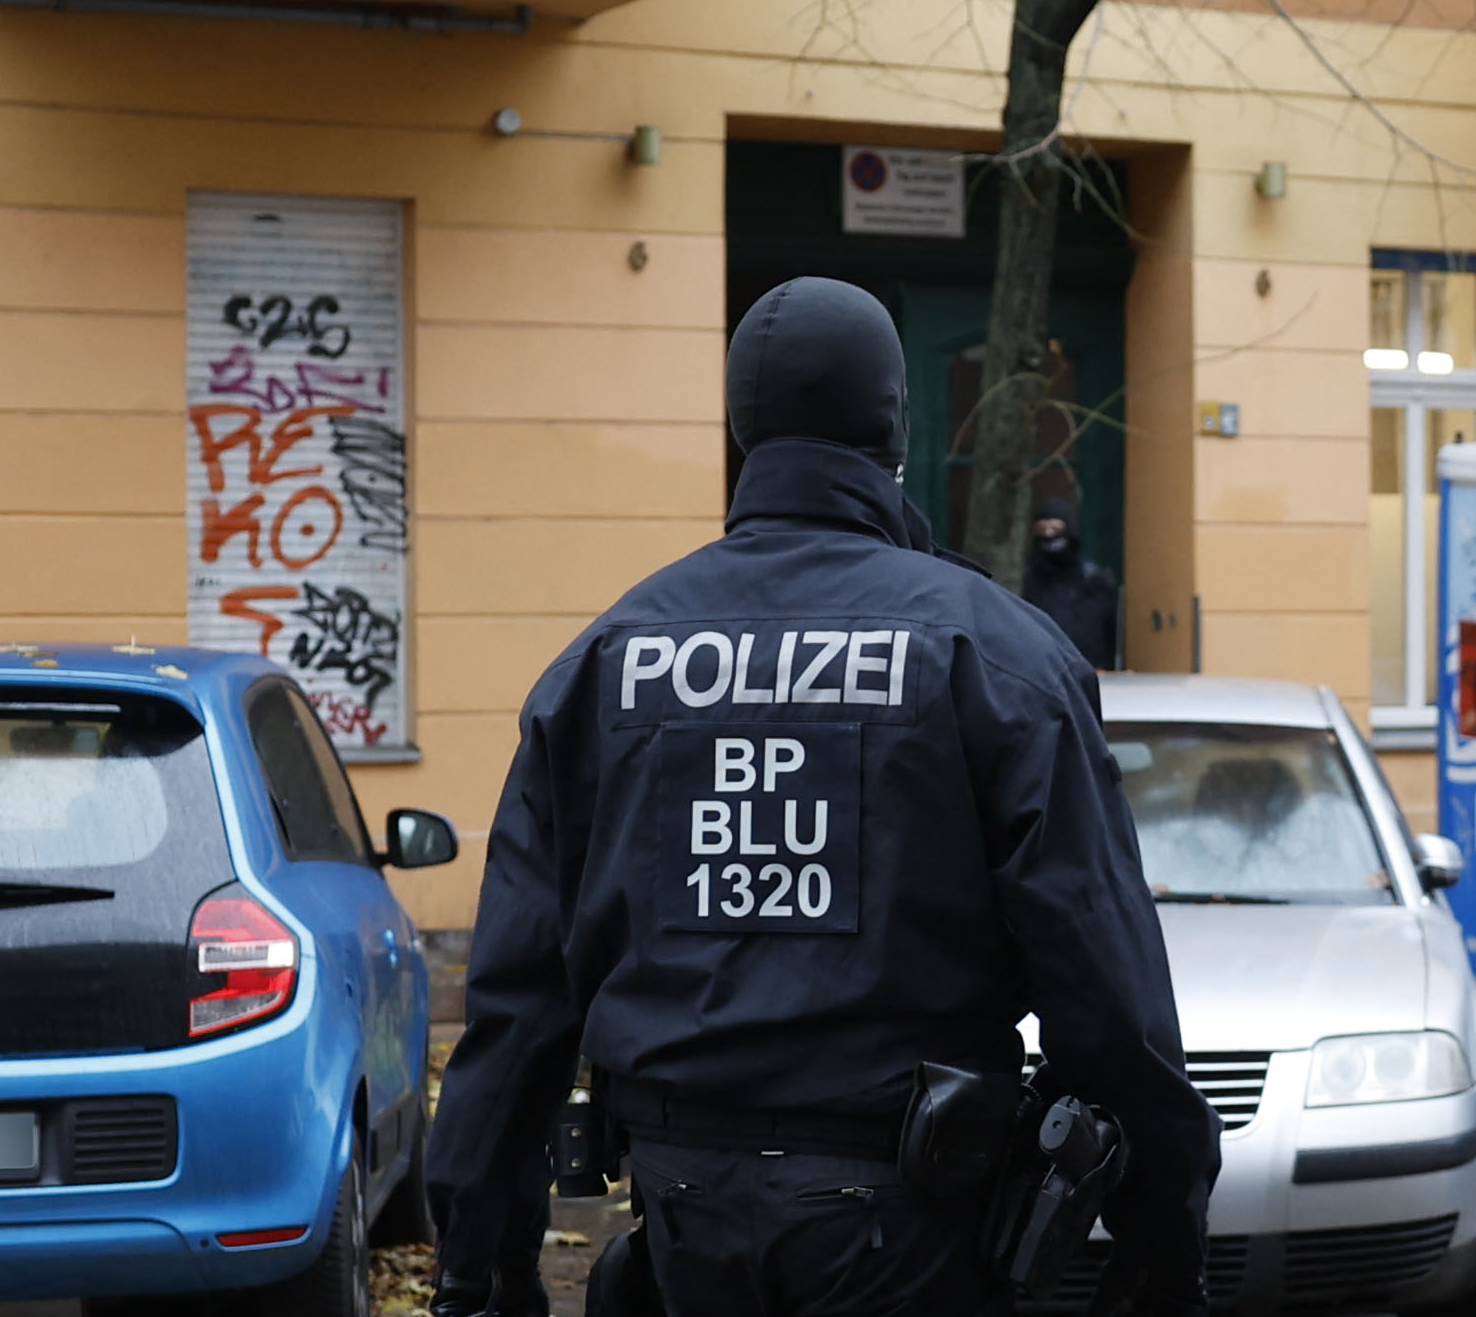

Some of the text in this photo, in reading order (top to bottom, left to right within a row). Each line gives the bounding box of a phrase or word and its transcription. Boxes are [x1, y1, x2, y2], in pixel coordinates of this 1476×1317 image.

[621, 629, 911, 710] POLIZEI
[714, 738, 807, 793] BP
[690, 799, 829, 857] BLU
[685, 863, 833, 919] 1320
